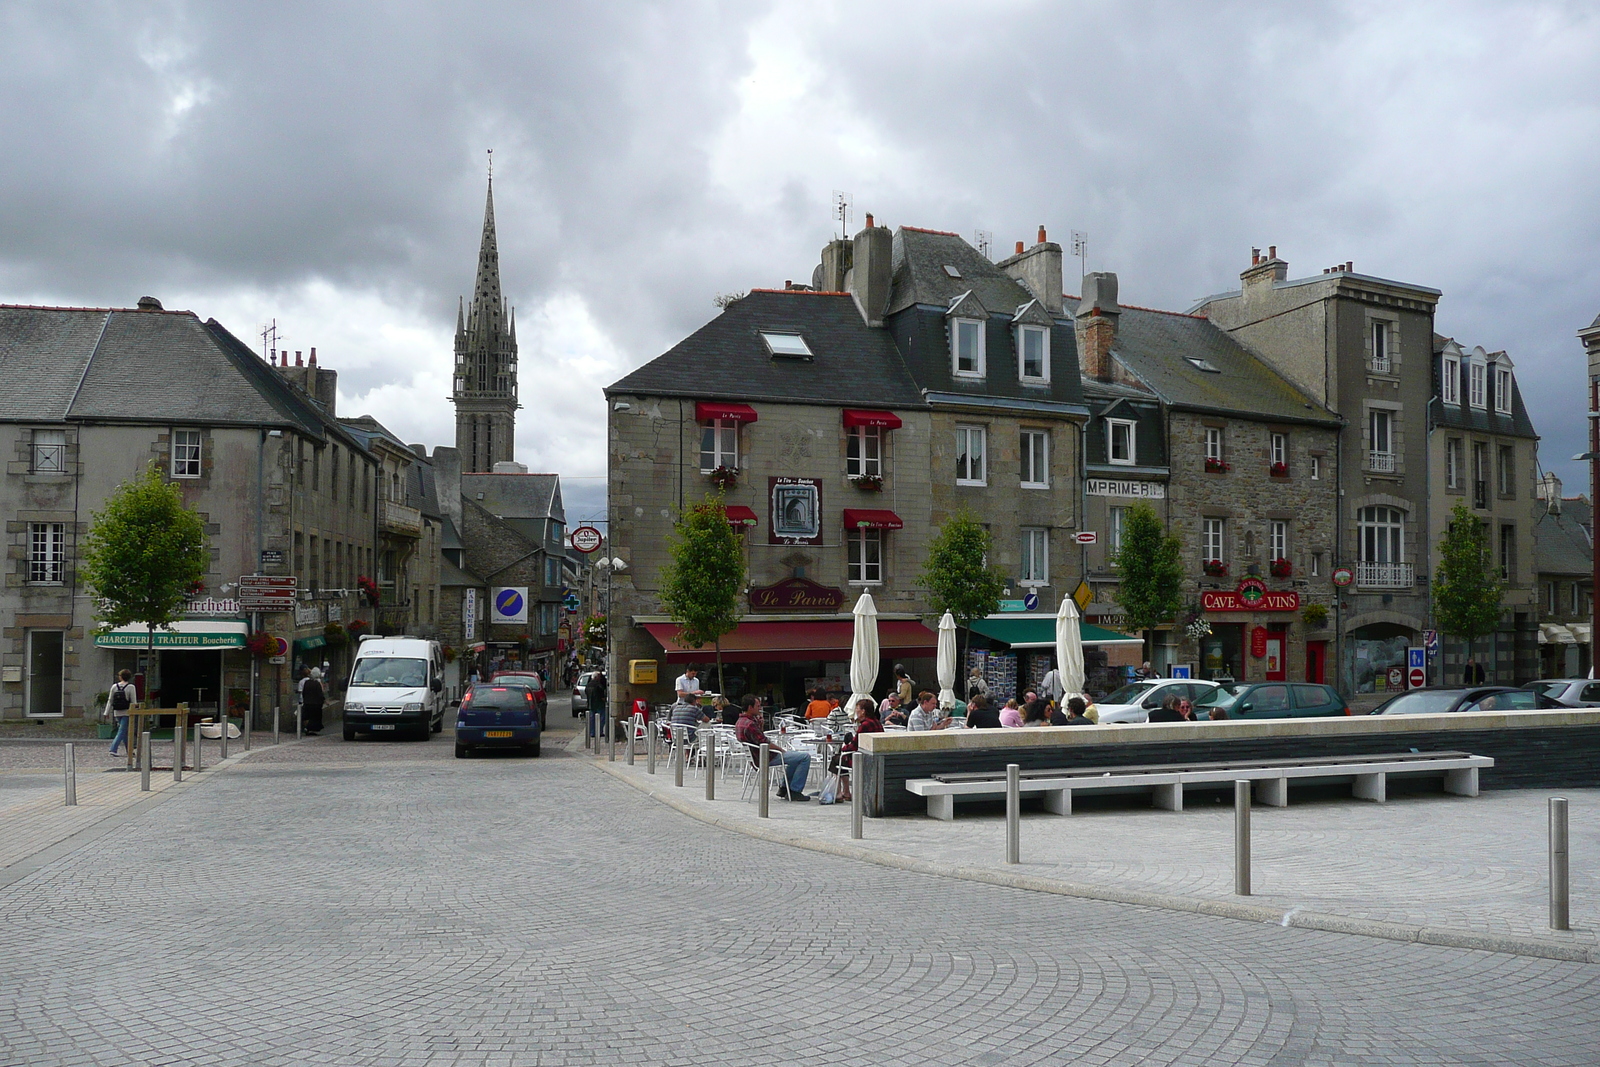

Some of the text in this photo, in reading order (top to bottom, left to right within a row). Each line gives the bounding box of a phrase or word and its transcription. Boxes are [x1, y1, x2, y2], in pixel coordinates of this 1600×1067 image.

[1249, 580, 1264, 590] VIGNES
[760, 589, 836, 606] Le Parvis
[1204, 593, 1296, 609] CAVE VINS
[467, 589, 475, 638] PARFUMERIE
[158, 636, 199, 645] TRAITEUR
[202, 636, 237, 645] Boucherie
